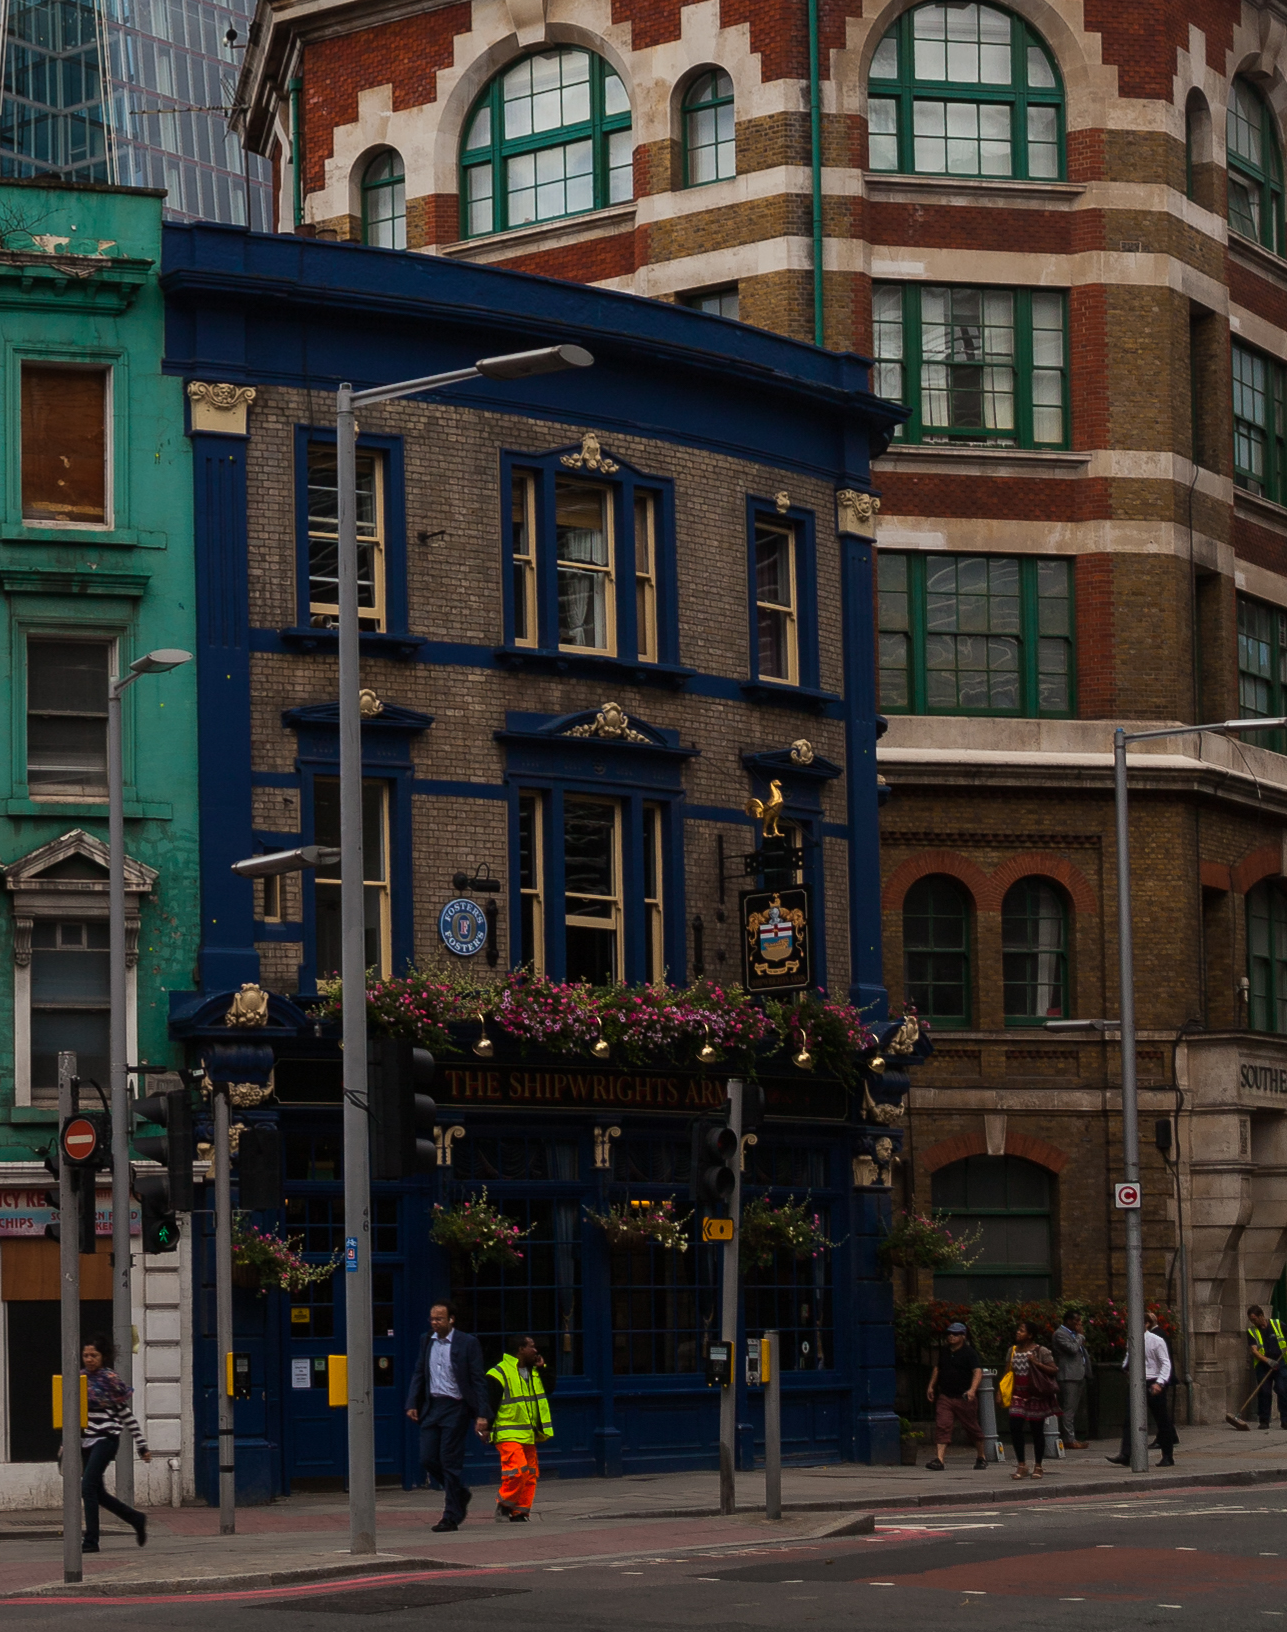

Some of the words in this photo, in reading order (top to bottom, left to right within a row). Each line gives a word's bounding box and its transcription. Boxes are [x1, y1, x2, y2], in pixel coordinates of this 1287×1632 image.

[445, 902, 483, 924] FOSTER'S
[460, 920, 470, 934] F
[445, 931, 483, 952] FOSTER'S
[446, 1071, 501, 1096] THE
[509, 1072, 678, 1102] SHIPWRIGHTS
